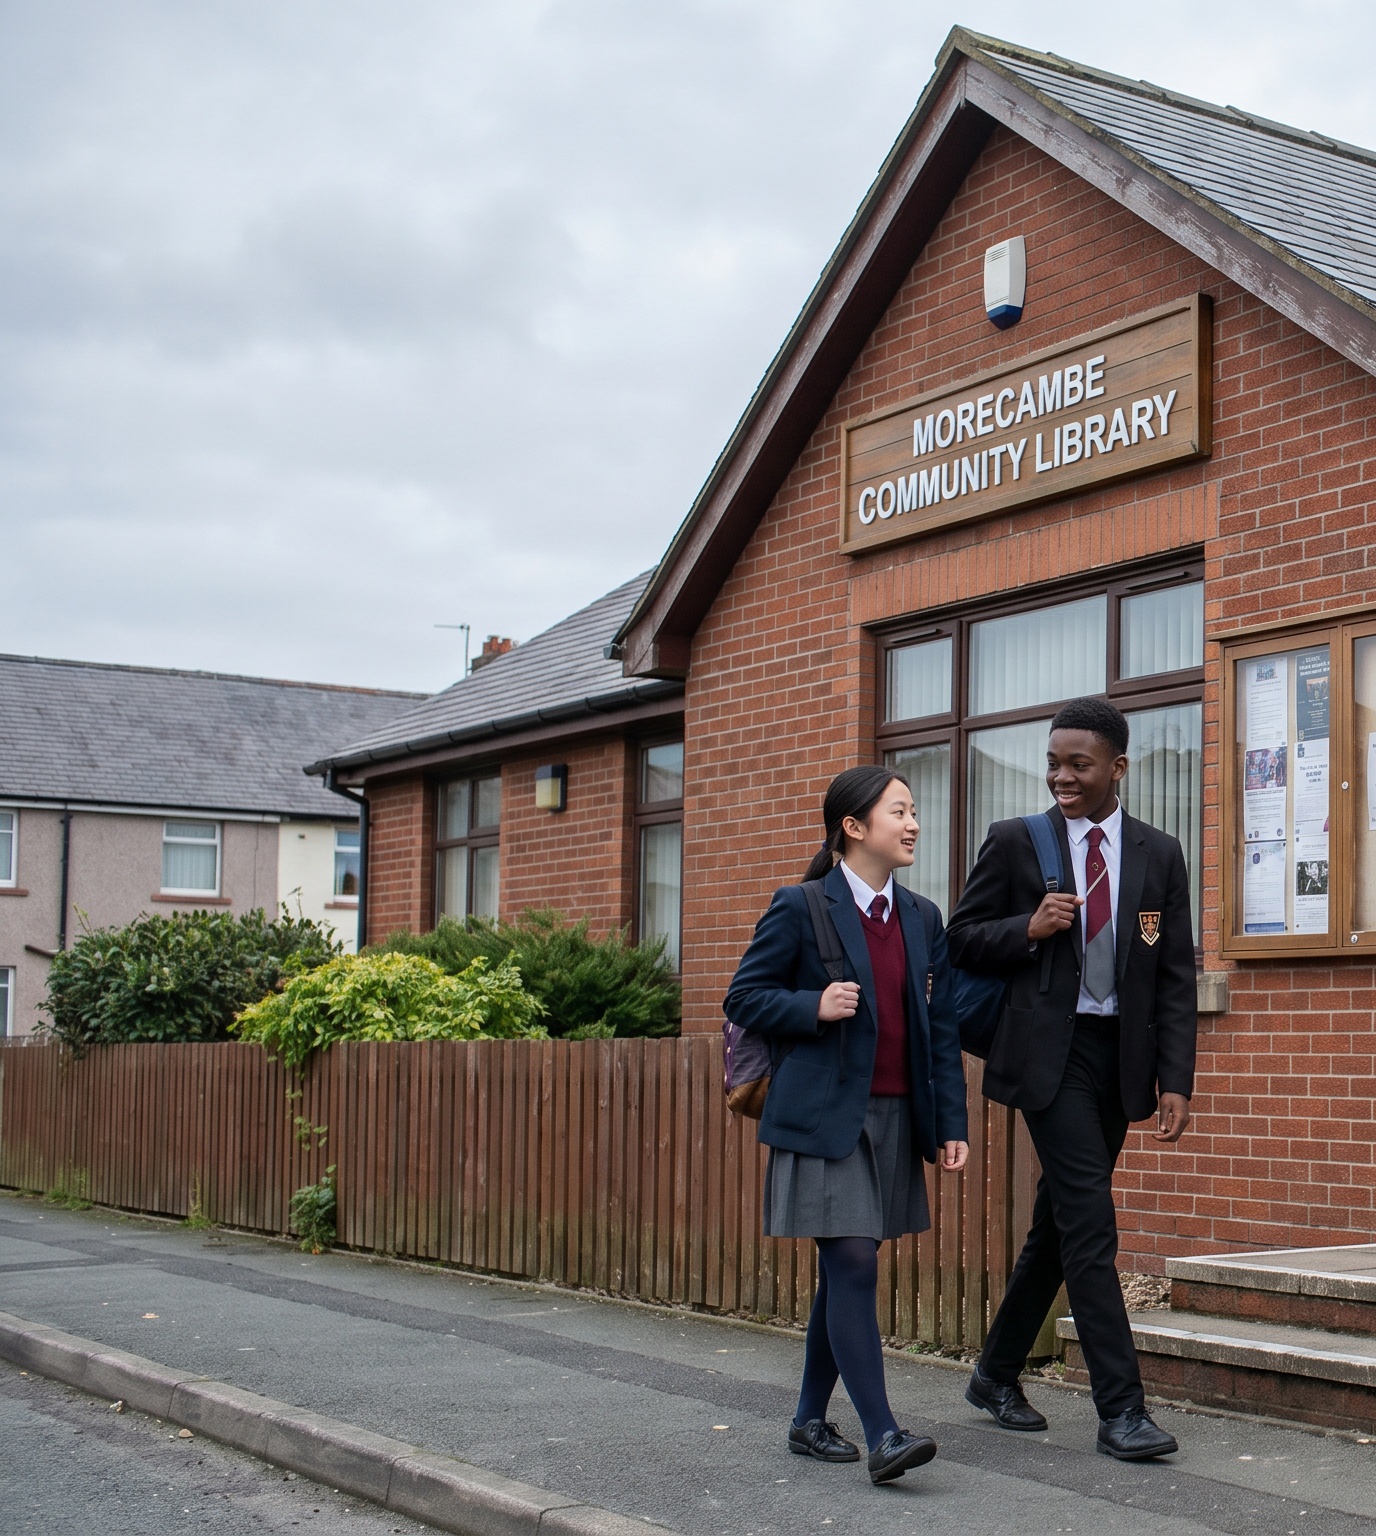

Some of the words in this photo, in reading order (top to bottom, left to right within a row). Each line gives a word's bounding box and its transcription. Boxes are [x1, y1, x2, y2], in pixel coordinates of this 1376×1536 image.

[858, 437, 1028, 525] COMMUNITY
[1035, 389, 1177, 473] LIBRARY
[912, 354, 1105, 458] MORECAMBE
